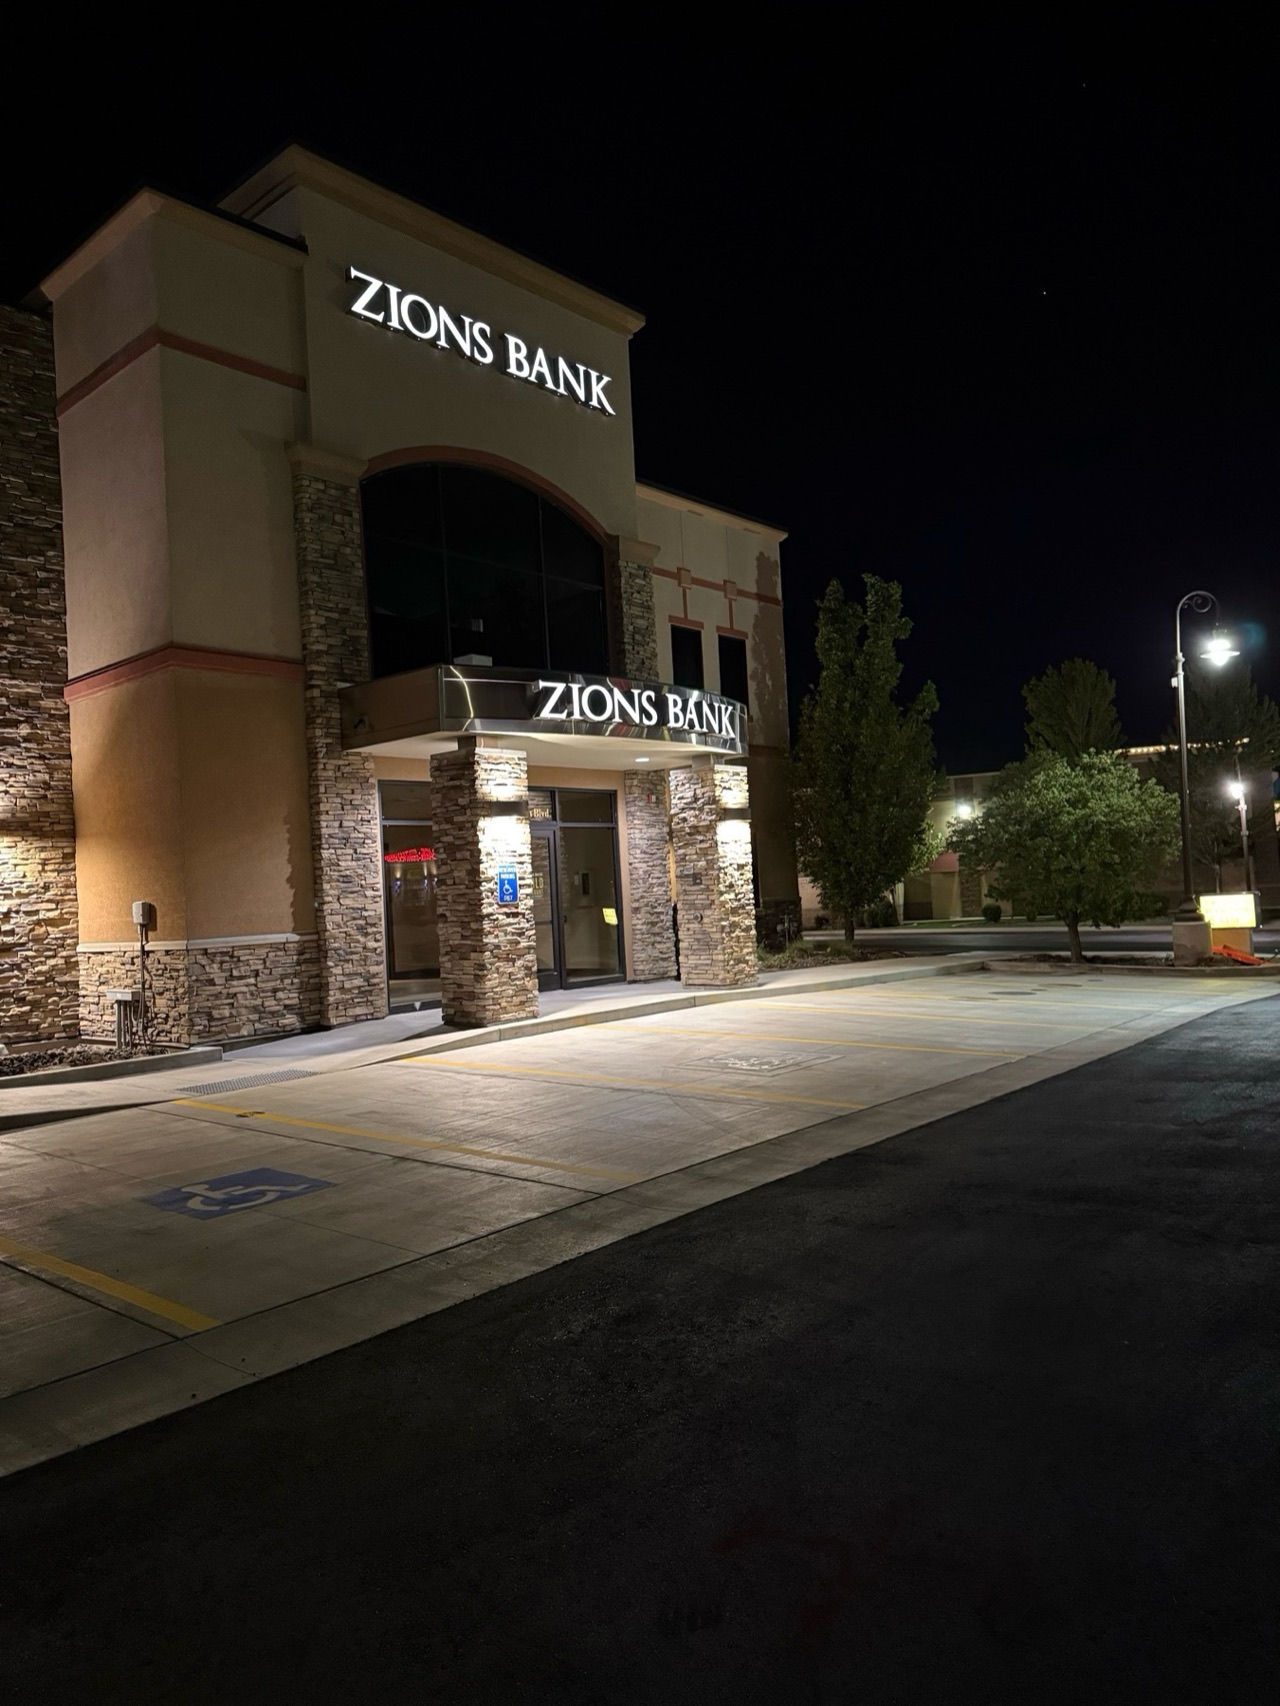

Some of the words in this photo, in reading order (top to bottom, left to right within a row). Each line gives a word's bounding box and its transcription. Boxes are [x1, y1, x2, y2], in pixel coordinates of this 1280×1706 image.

[350, 265, 494, 365] ZIONS
[504, 332, 616, 416] BANK
[539, 679, 658, 726] ZIONS
[665, 692, 736, 738] BANK
